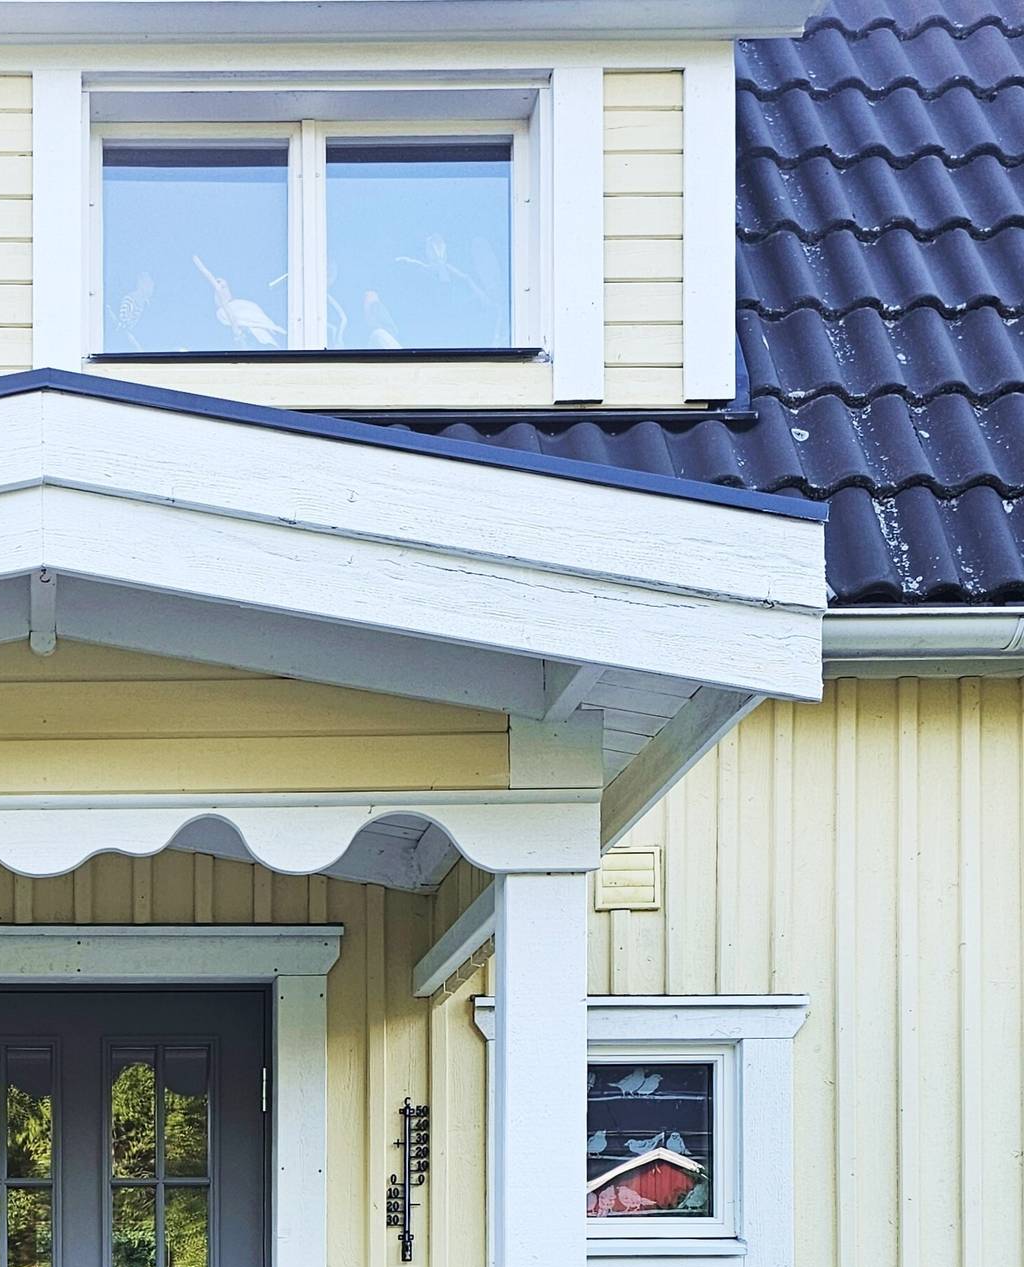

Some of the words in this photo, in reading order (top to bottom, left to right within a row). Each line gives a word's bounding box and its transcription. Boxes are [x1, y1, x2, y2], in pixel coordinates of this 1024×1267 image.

[416, 1105, 429, 1116] 50
[416, 1119, 429, 1130] 40
[416, 1133, 429, 1143] 30
[416, 1146, 429, 1157] 20
[417, 1160, 429, 1171] 10
[390, 1174, 397, 1183] 0
[418, 1174, 425, 1183] 0
[387, 1188, 400, 1198] 10
[386, 1201, 400, 1211] 20
[386, 1215, 400, 1225] 30
